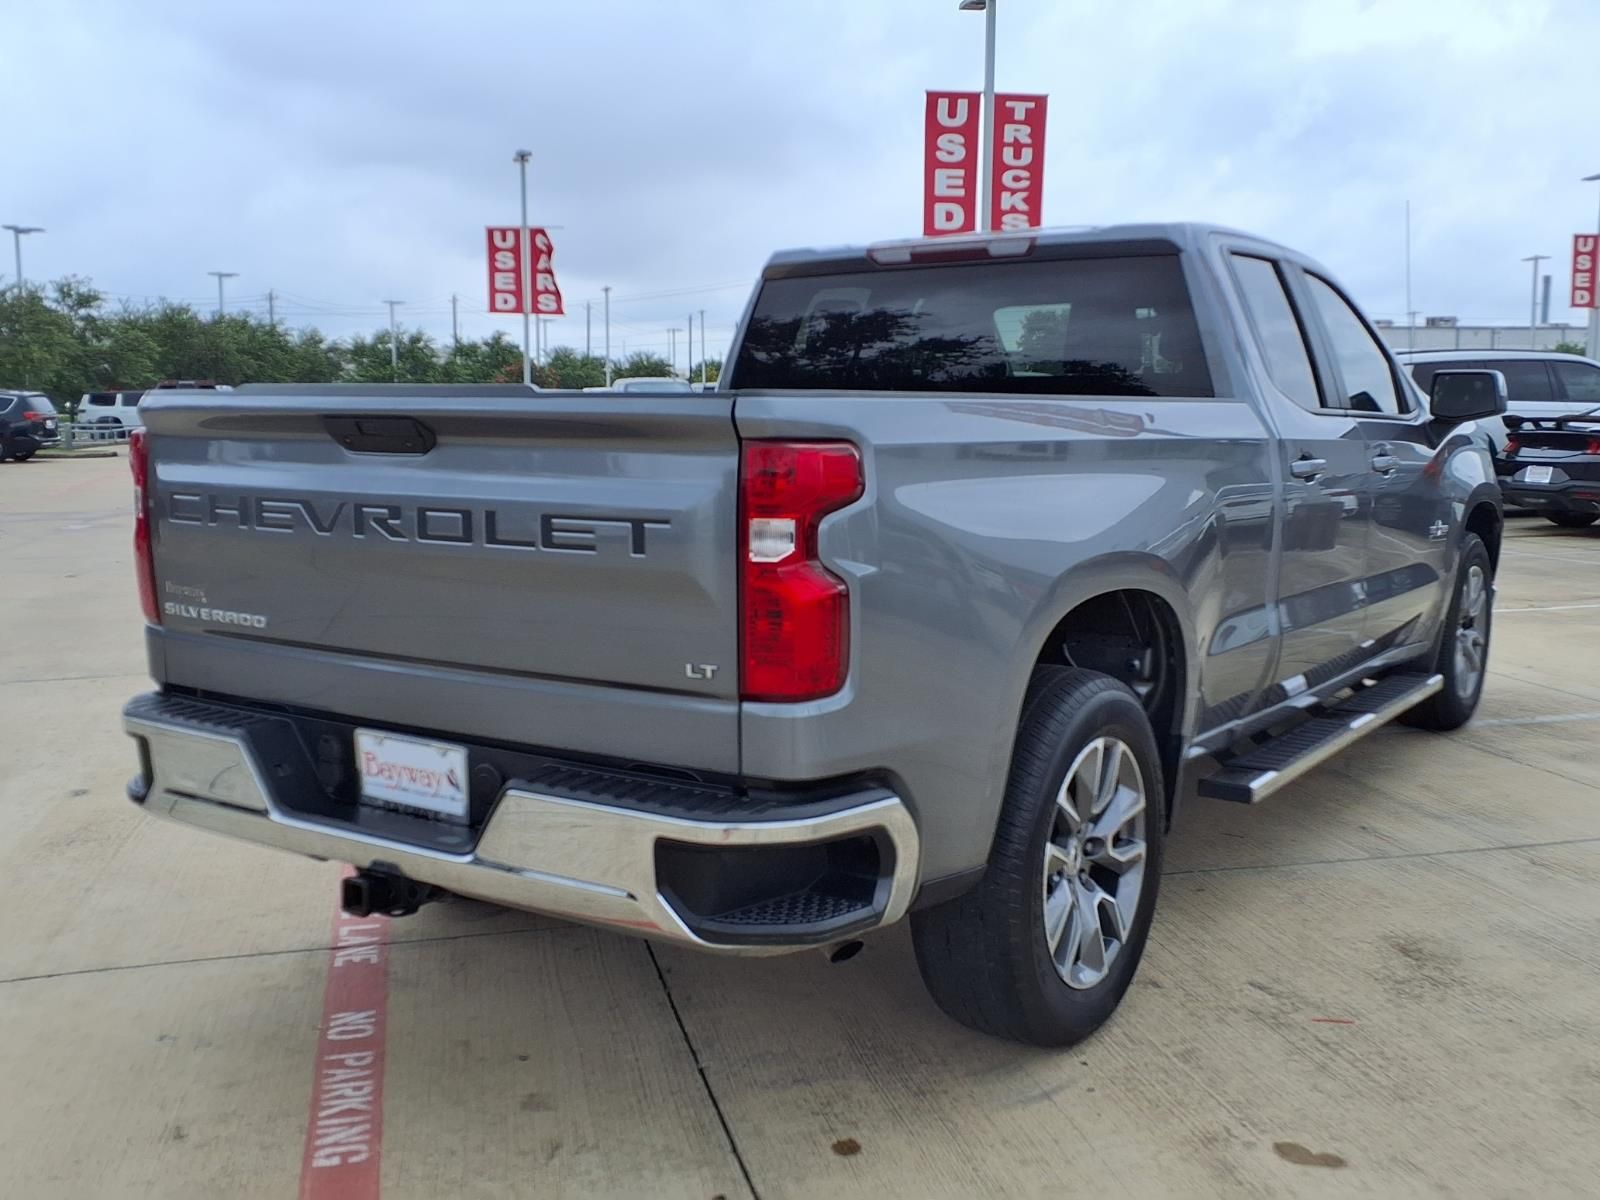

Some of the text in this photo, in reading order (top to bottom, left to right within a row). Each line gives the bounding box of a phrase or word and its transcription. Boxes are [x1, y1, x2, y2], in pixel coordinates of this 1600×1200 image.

[933, 97, 1036, 231] USED TRUCKS
[493, 230, 558, 312] USED CARS
[1574, 237, 1594, 305] USED
[169, 491, 672, 559] CHEVROLET
[164, 602, 268, 629] SILVERADO
[685, 663, 718, 680] LT
[334, 924, 381, 967] LANE
[326, 1009, 377, 1041] NO
[311, 1051, 375, 1168] PARKING
